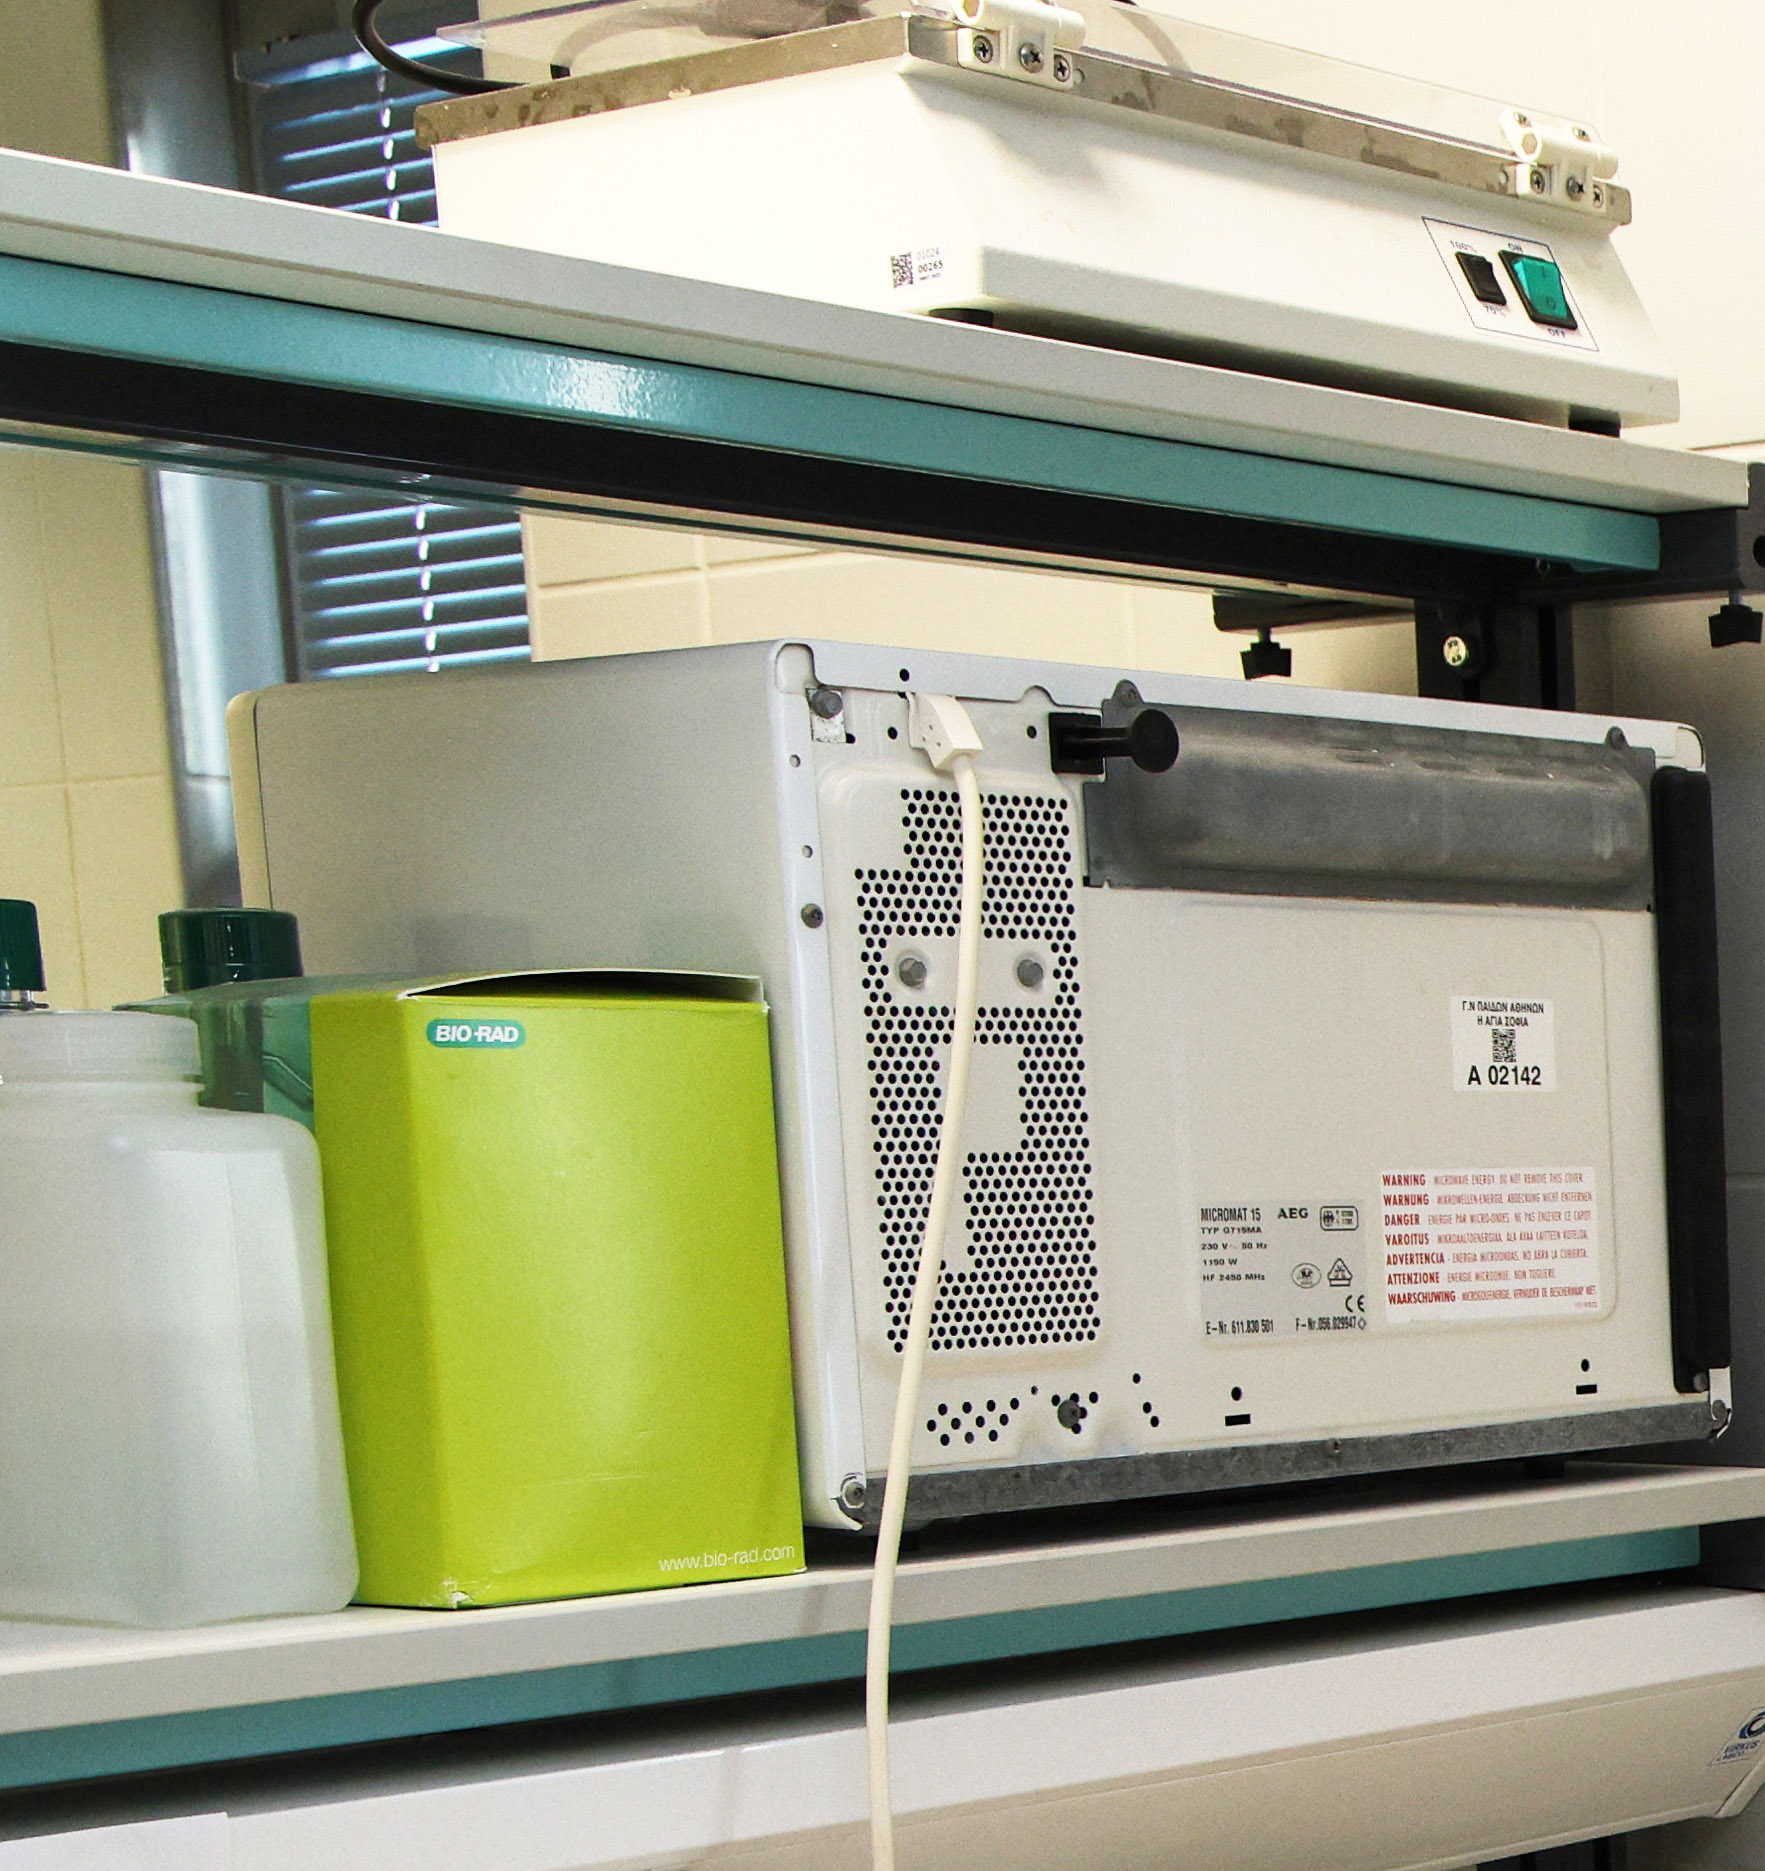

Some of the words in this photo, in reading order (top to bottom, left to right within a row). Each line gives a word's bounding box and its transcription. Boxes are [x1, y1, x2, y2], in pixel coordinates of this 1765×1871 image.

[435, 1025, 519, 1043] BIO-RAD
[1488, 1064, 1541, 1085] 02142
[1382, 1174, 1426, 1186] WARNING
[1383, 1193, 1430, 1206] WARNUNG
[1200, 1207, 1248, 1222] MICROMAT
[1251, 1207, 1262, 1222] 15
[1277, 1208, 1308, 1219] AEG
[1384, 1213, 1420, 1226] DANGER
[1200, 1226, 1219, 1235] TYP
[1385, 1233, 1430, 1246] VAROITUS
[1201, 1242, 1219, 1251] 230
[1256, 1242, 1267, 1250] Hz
[1203, 1258, 1225, 1266] 1150
[1228, 1257, 1238, 1266] W
[1386, 1252, 1445, 1266] ADVERTENCIA
[1202, 1273, 1215, 1281] HF
[1245, 1273, 1265, 1281] MHz
[1387, 1271, 1440, 1285] ATTENZIONE
[1387, 1290, 1456, 1305] WAARSCHUWING
[658, 1545, 795, 1571] www.bio-rad.com
